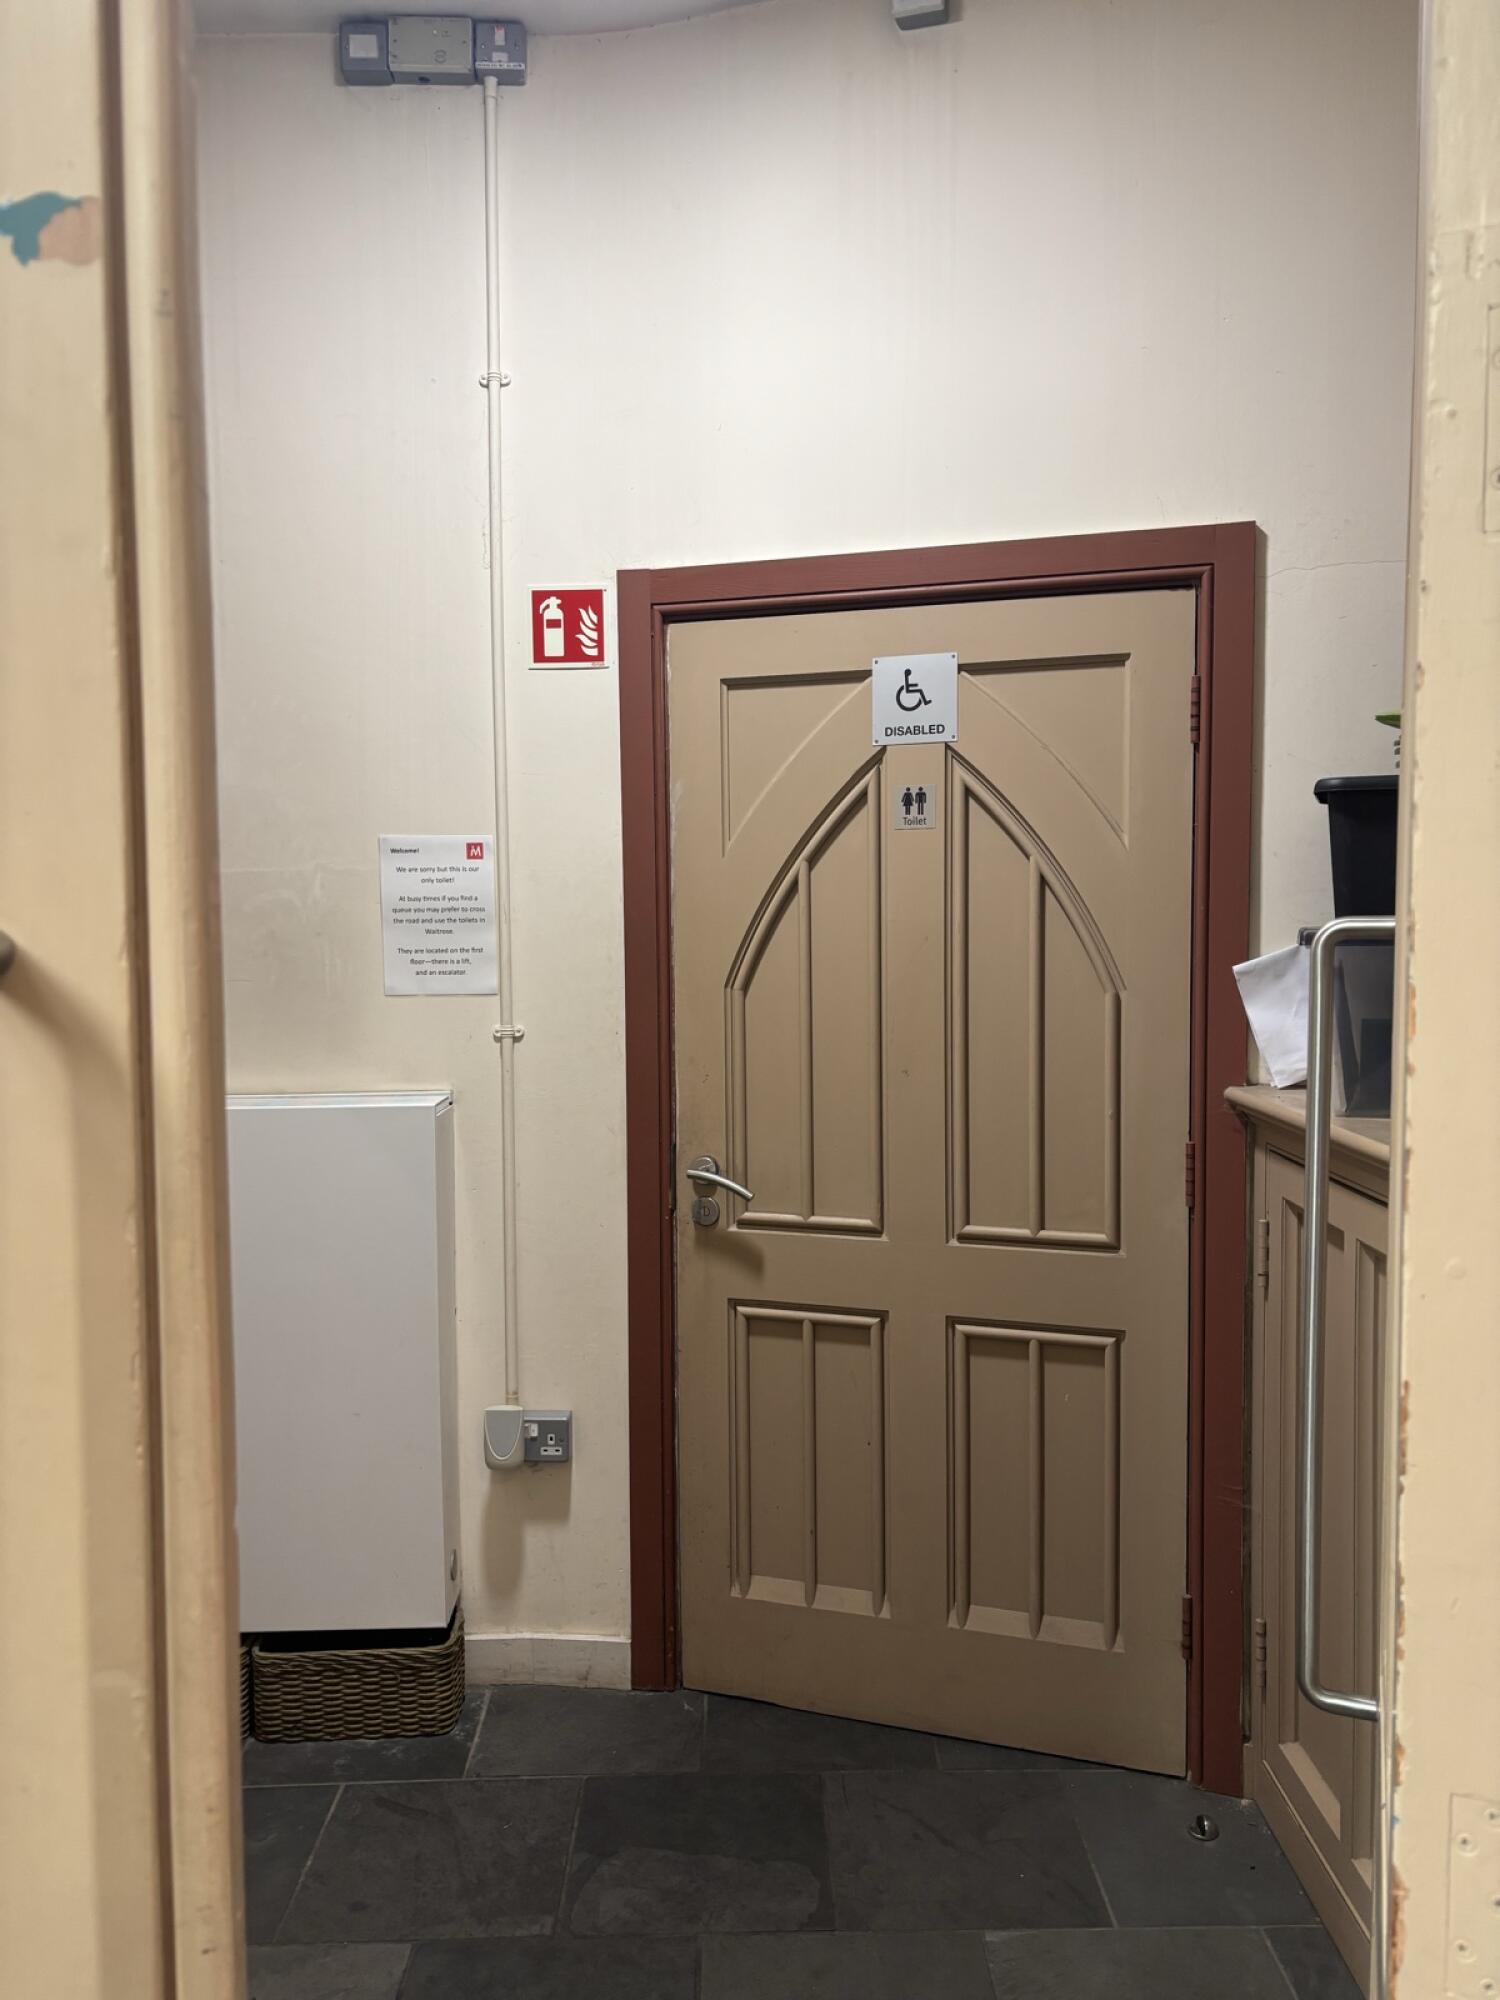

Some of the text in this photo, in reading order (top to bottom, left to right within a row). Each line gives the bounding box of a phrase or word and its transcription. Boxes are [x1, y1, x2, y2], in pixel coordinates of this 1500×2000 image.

[885, 724, 946, 737] DISABLED
[903, 816, 928, 827] Toilet
[389, 847, 420, 855] Welcome!
[398, 947, 413, 955] They
